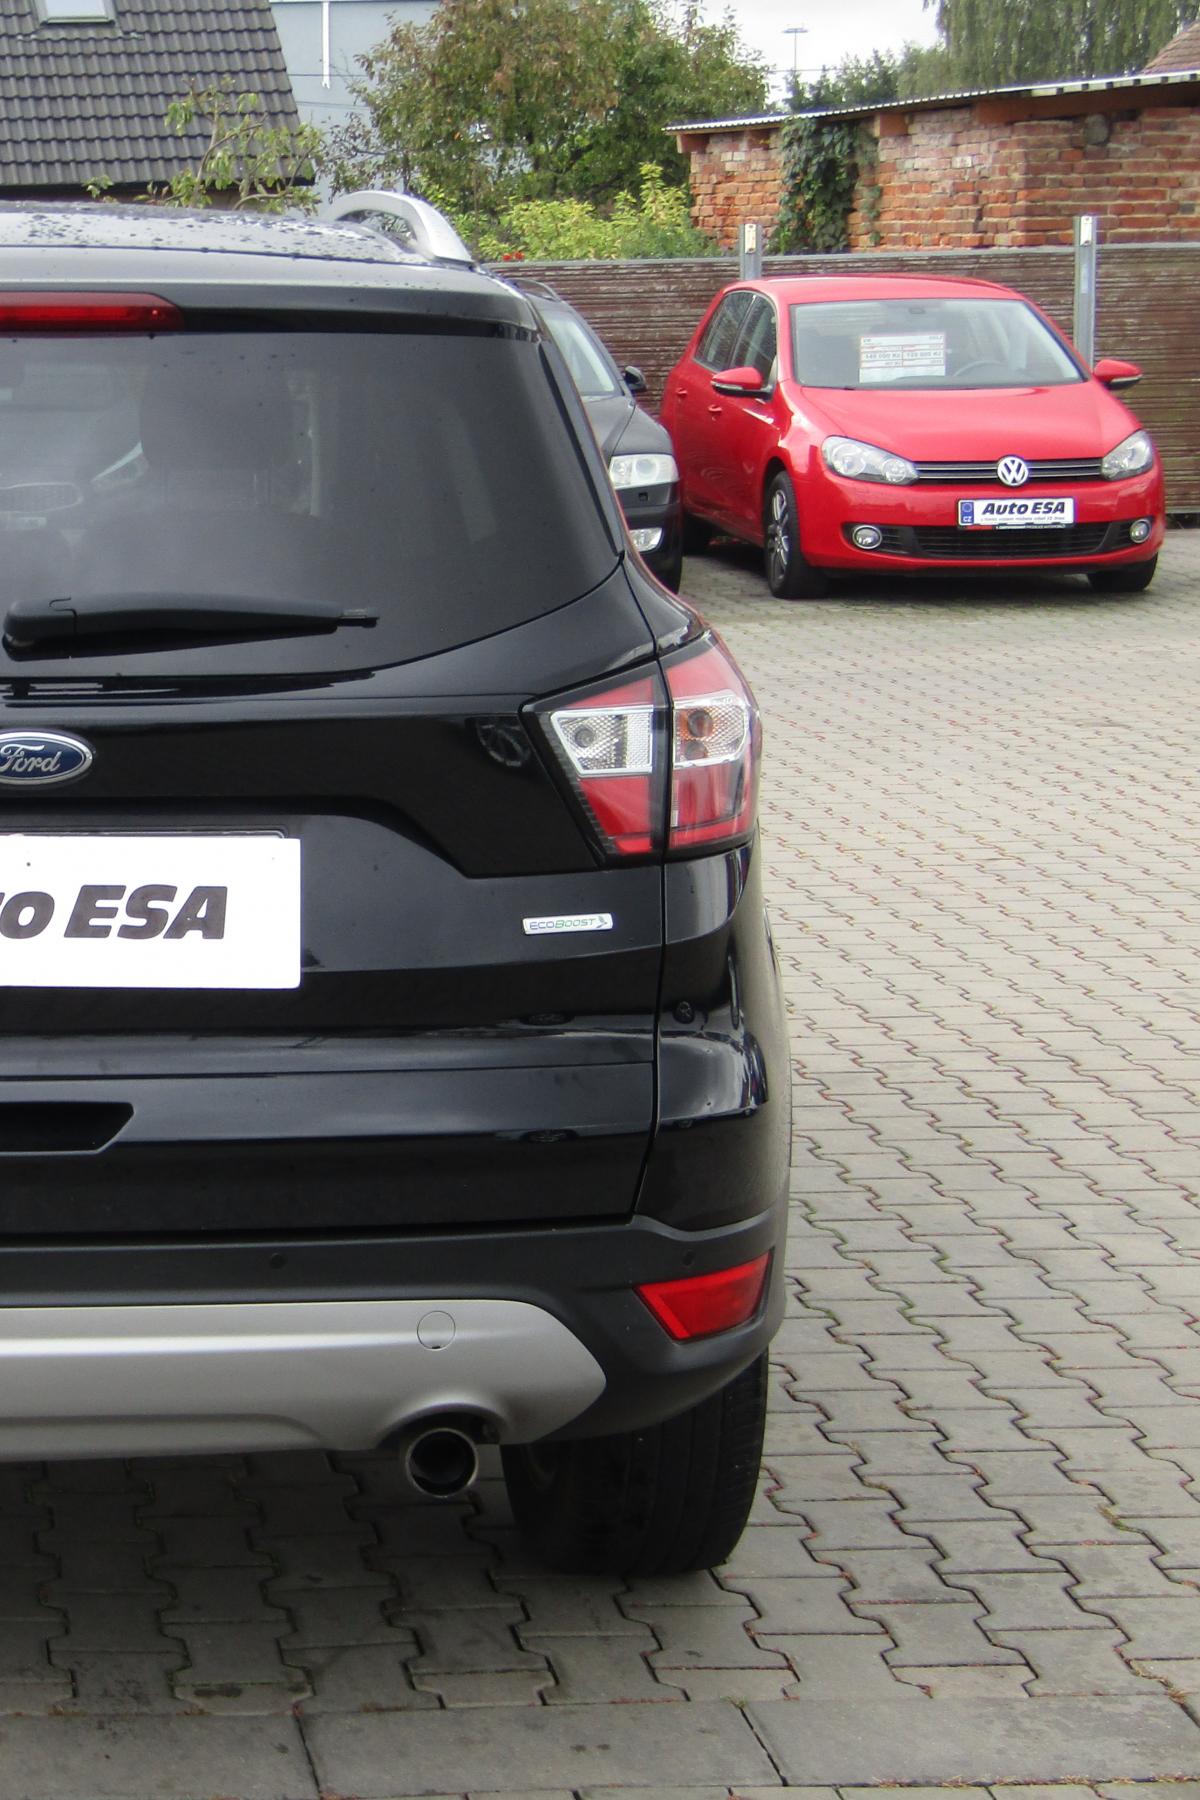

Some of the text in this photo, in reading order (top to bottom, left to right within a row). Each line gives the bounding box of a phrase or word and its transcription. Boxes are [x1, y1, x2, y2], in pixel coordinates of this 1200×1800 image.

[982, 501, 1065, 515] Auto ESA
[64, 884, 228, 939] ESA
